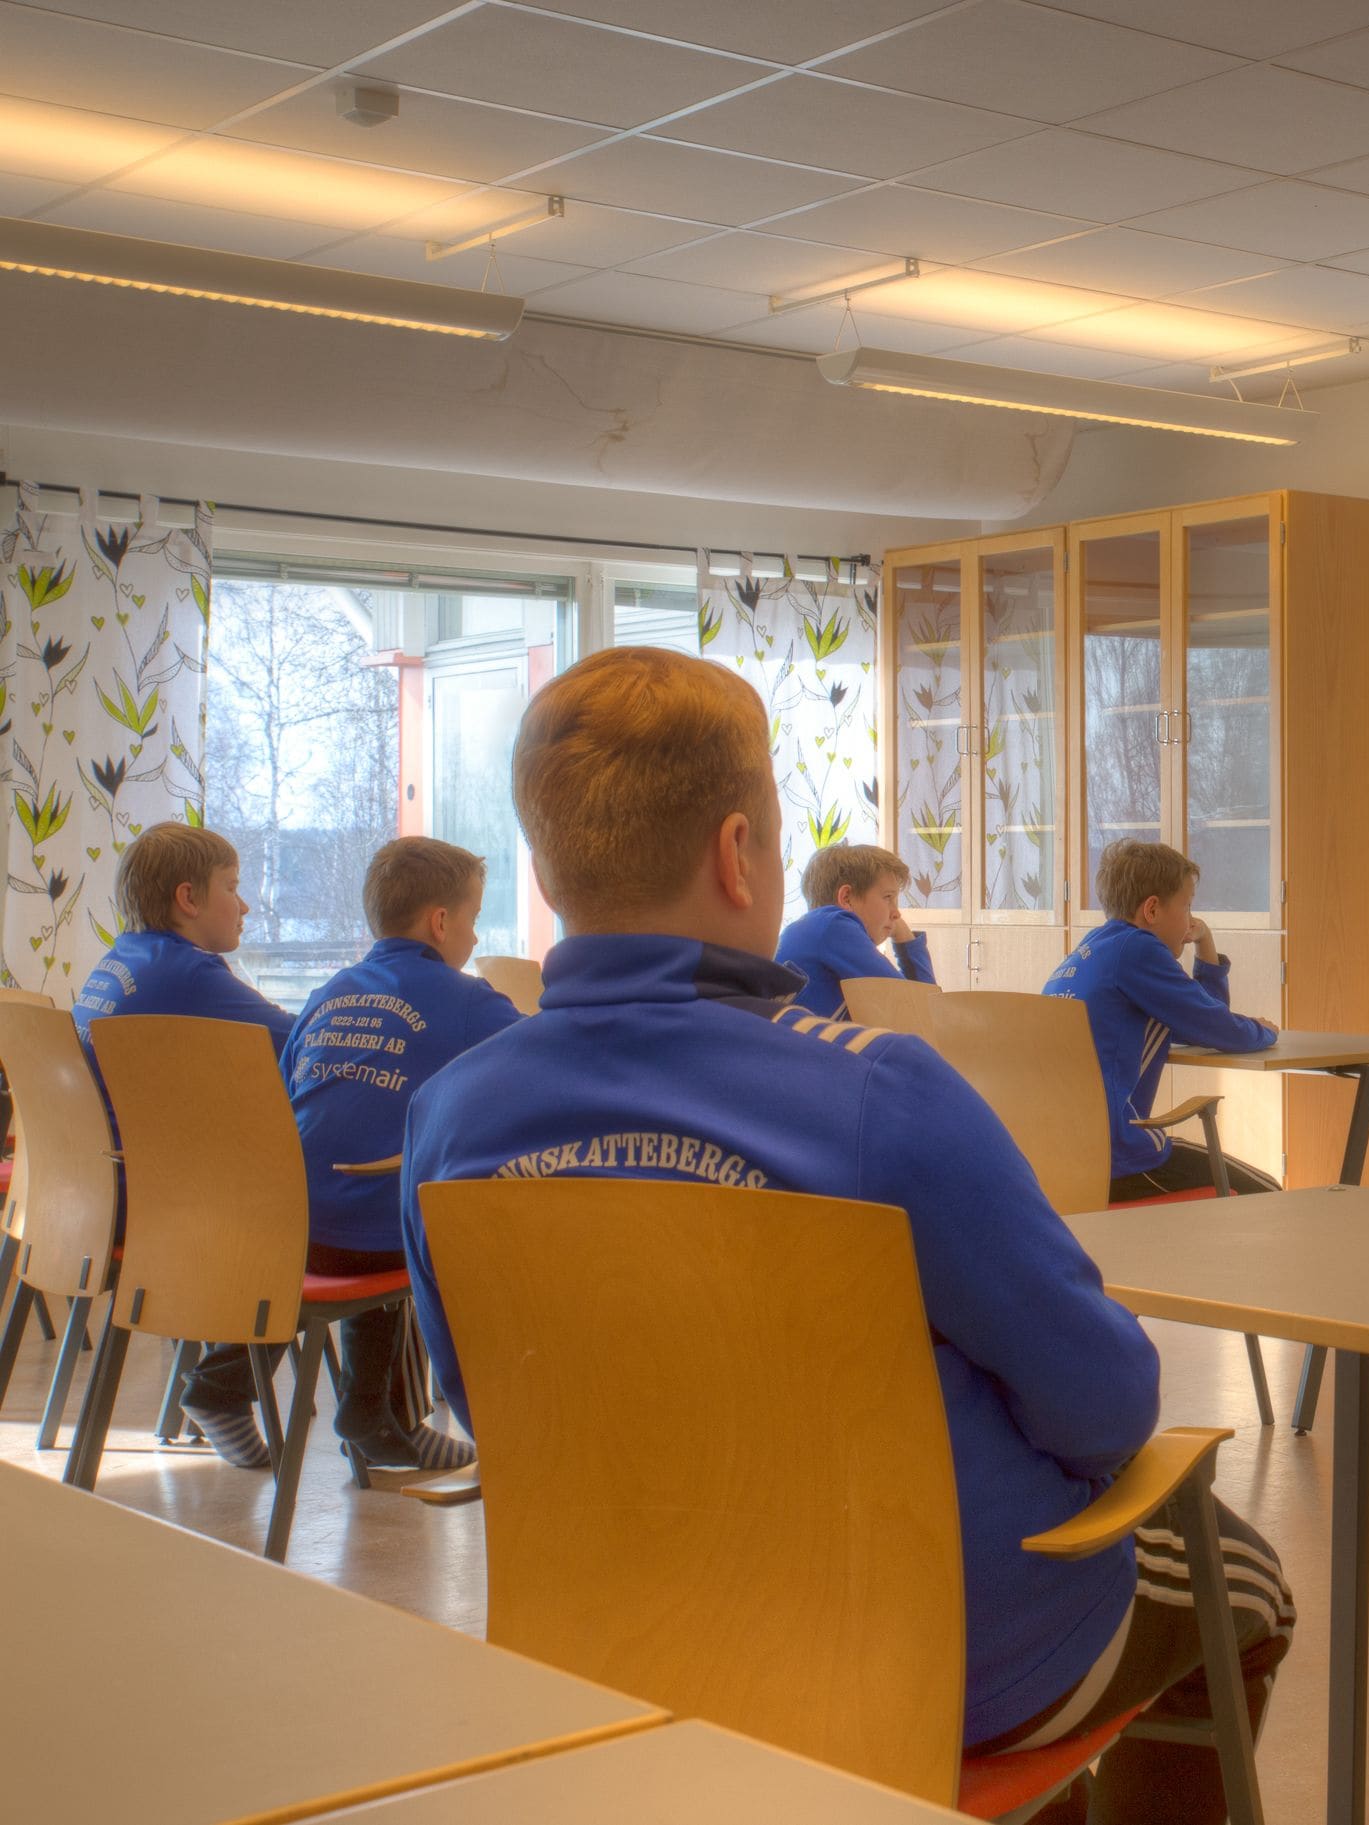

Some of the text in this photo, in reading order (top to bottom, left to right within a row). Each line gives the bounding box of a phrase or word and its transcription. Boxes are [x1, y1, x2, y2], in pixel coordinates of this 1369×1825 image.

[304, 1029, 406, 1055] PLÅTSLAGERI AB
[311, 1061, 408, 1092] systemair
